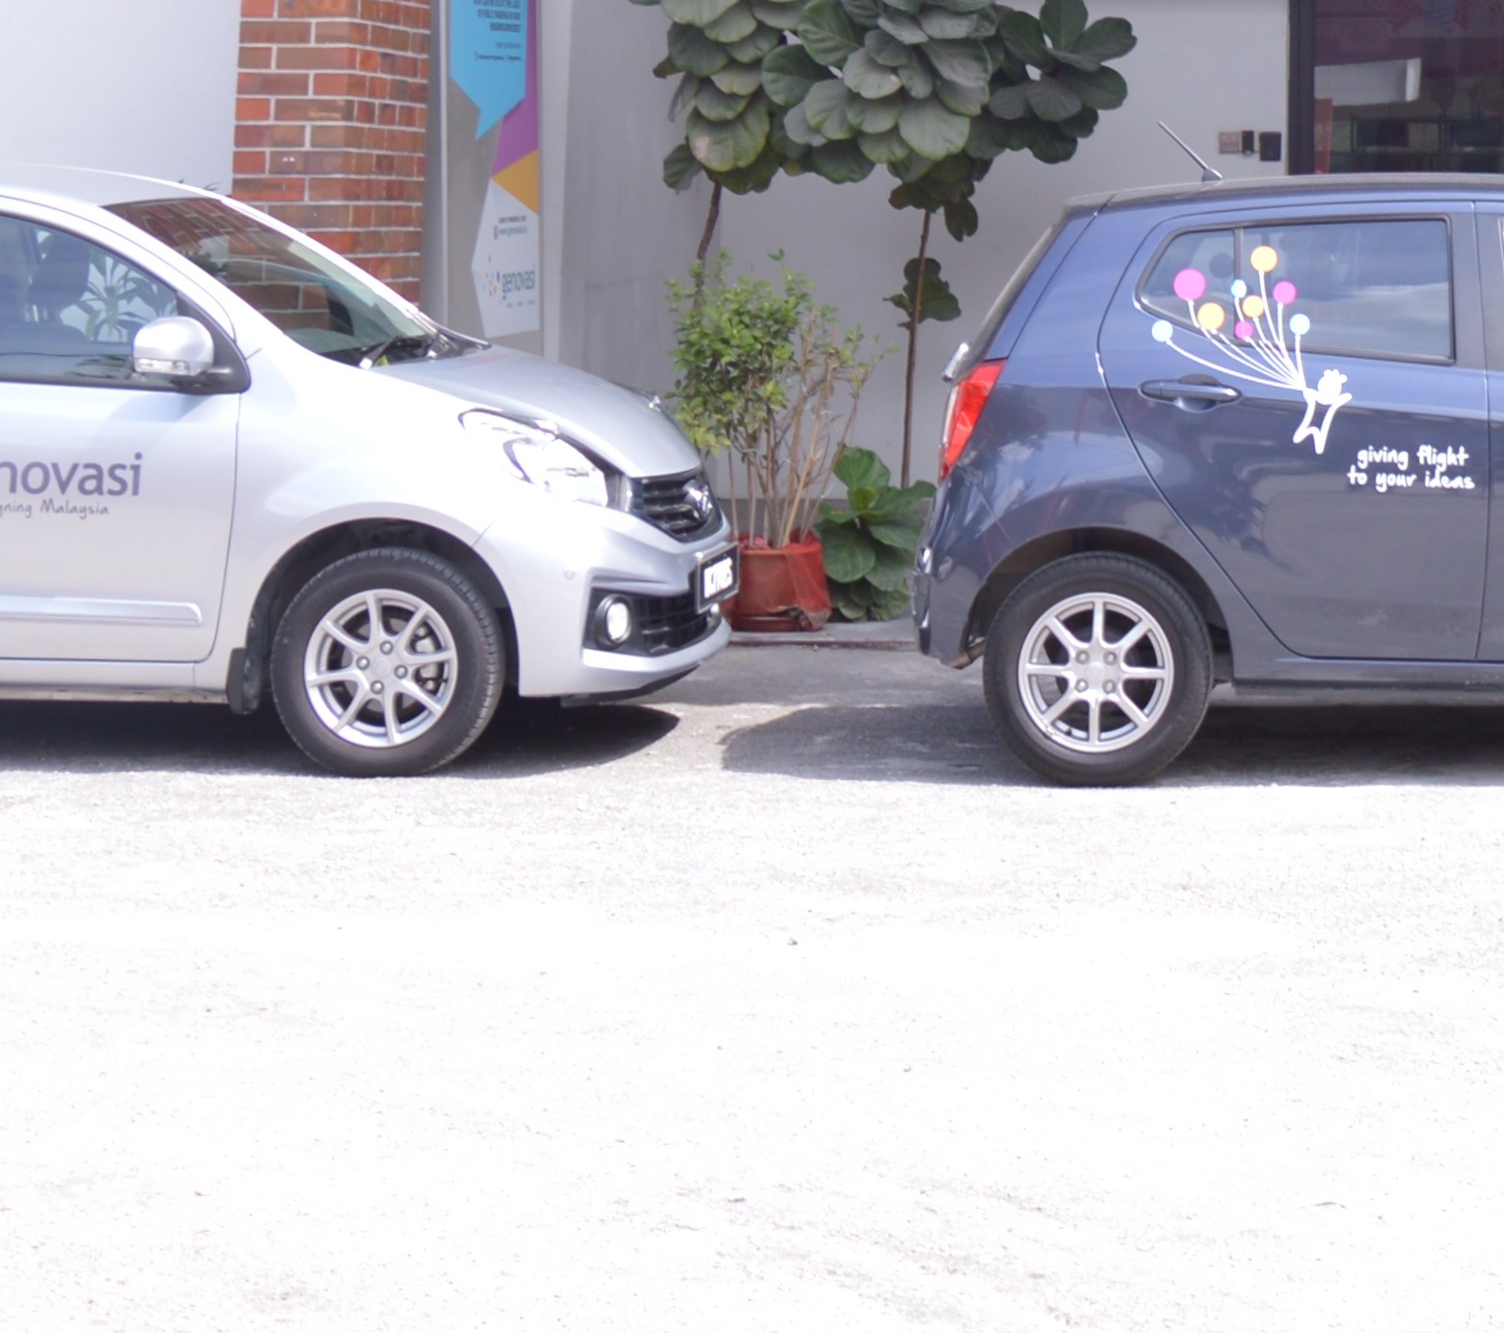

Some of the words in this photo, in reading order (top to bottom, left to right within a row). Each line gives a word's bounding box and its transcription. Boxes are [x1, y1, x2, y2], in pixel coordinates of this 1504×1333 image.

[1356, 445, 1409, 471] giving
[1416, 443, 1470, 472] flight
[1346, 464, 1368, 485] to
[1375, 472, 1417, 493] your
[1424, 468, 1476, 490] ideas
[39, 497, 110, 520] Malaysia
